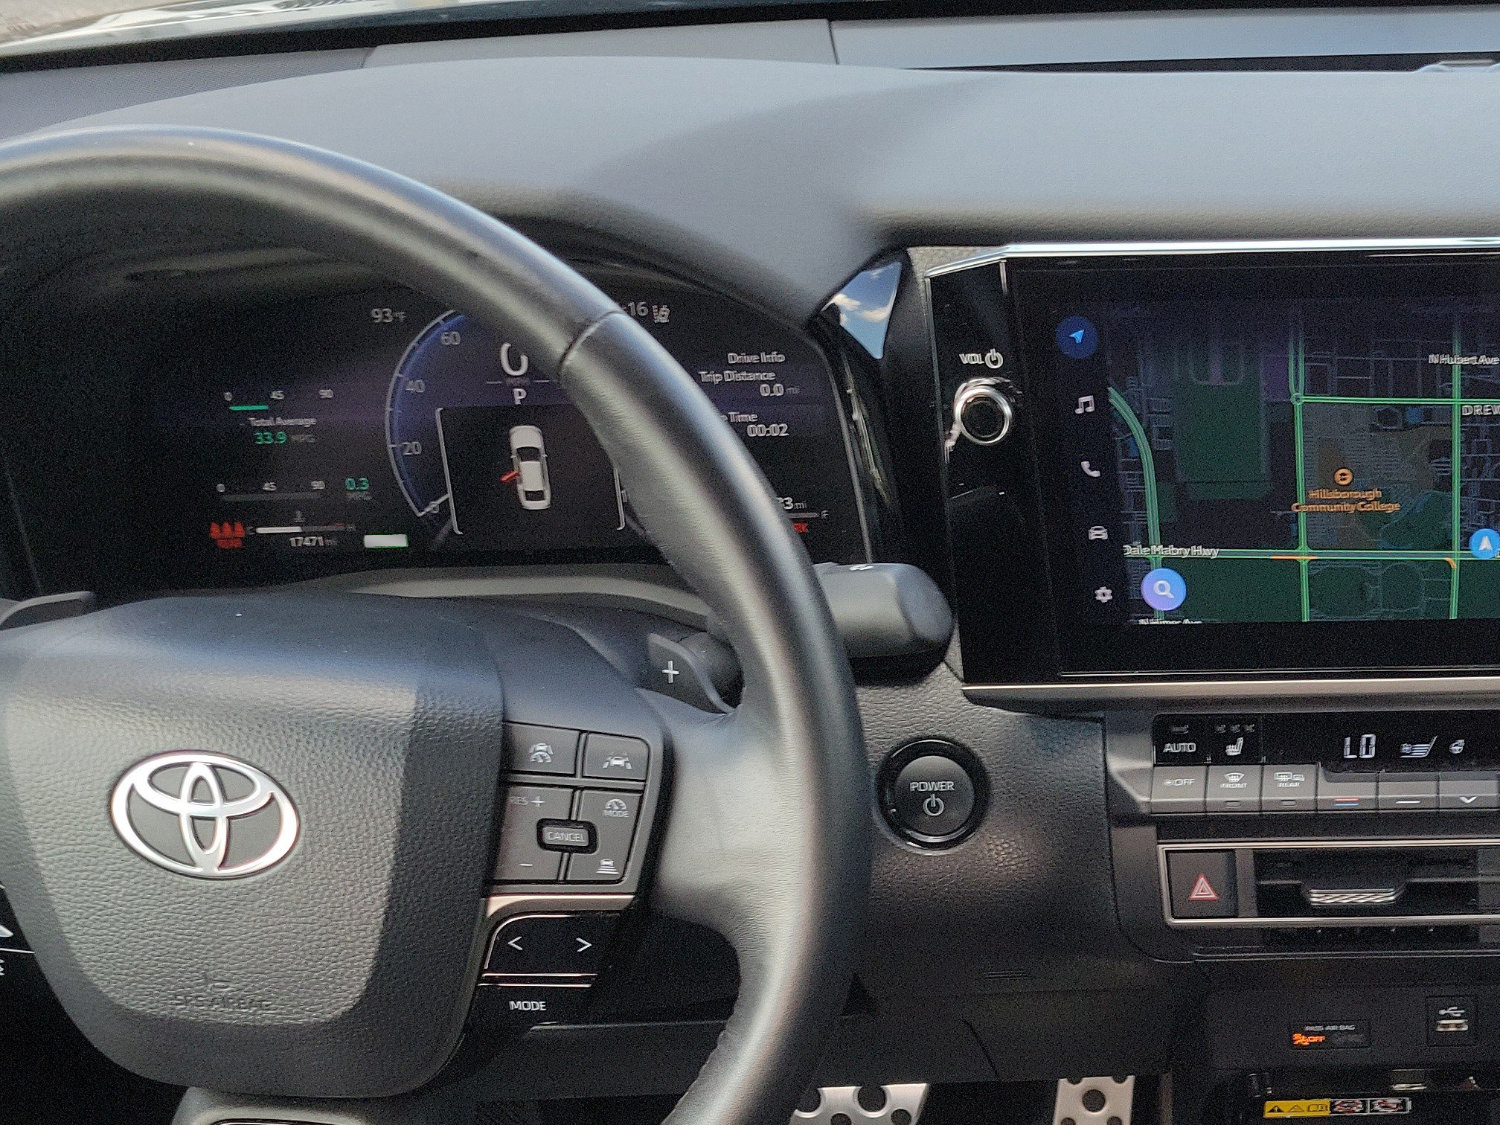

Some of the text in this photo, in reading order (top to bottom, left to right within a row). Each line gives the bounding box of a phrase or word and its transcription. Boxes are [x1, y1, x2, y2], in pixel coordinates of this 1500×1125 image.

[441, 331, 461, 345] 60
[727, 352, 786, 363] Drive Info
[959, 353, 985, 364] VOL
[1477, 354, 1500, 364] Ave
[699, 370, 776, 384] Trip Distance
[513, 388, 527, 405] P
[728, 411, 758, 423] Time
[747, 424, 789, 437] 00:02
[254, 431, 287, 445] 33.9
[402, 441, 422, 456] 20
[345, 477, 369, 490] 0.3
[1308, 489, 1382, 500] Hillsborough
[1291, 501, 1401, 514] Community College
[1123, 544, 1219, 559] Dale Mabry Hwy
[1163, 742, 1196, 753] AUTO
[910, 781, 955, 792] POWER
[1174, 778, 1195, 787] OFF
[547, 831, 584, 842] CANCEL
[509, 1000, 547, 1011] MODE
